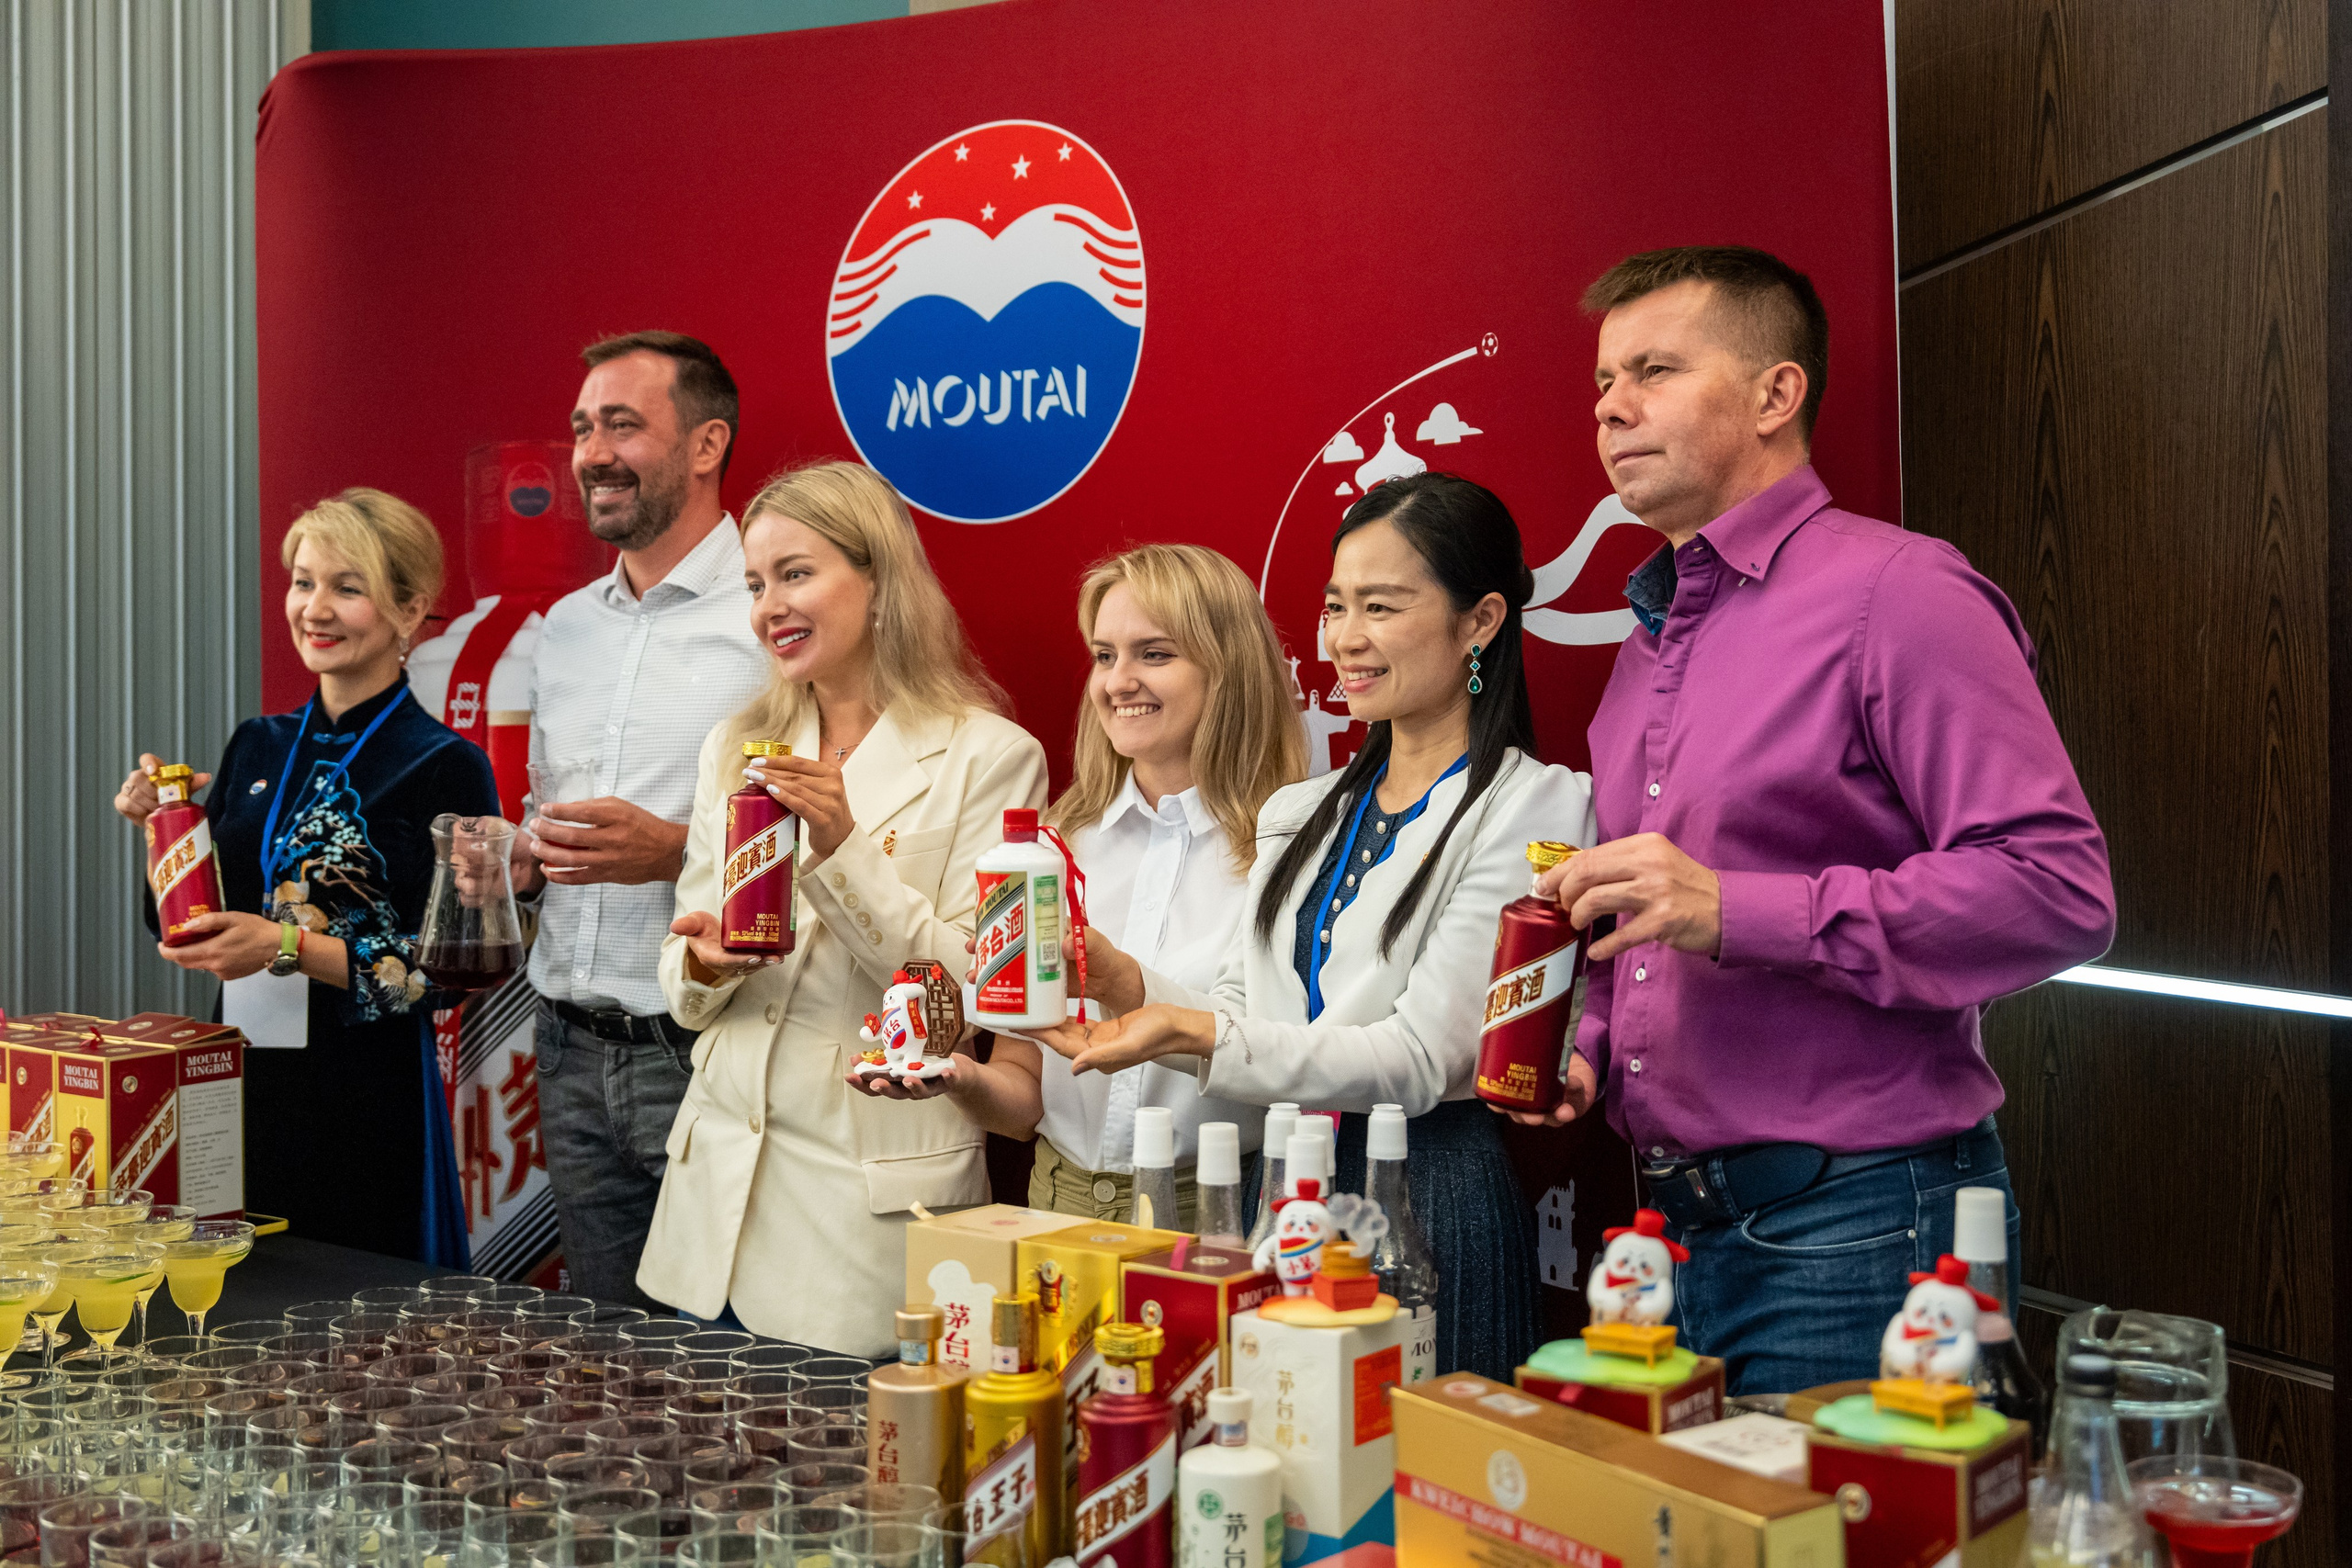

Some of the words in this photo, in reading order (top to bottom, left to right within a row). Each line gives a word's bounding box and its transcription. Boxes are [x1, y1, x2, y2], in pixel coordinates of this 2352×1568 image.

[886, 364, 1087, 433] MOUTAI
[723, 829, 776, 897] 臺迎賓酒
[976, 902, 1023, 971] 茅台酒
[187, 1051, 232, 1067] MOUTAI
[64, 1065, 98, 1079] MOUTAI
[185, 1061, 234, 1078] YINGBIN
[1507, 1069, 1538, 1082] YINGBIN
[1509, 1062, 1537, 1074] MOUTAI
[63, 1075, 99, 1090] YINGBIN
[1077, 1468, 1148, 1551] 臺迎賓酒
